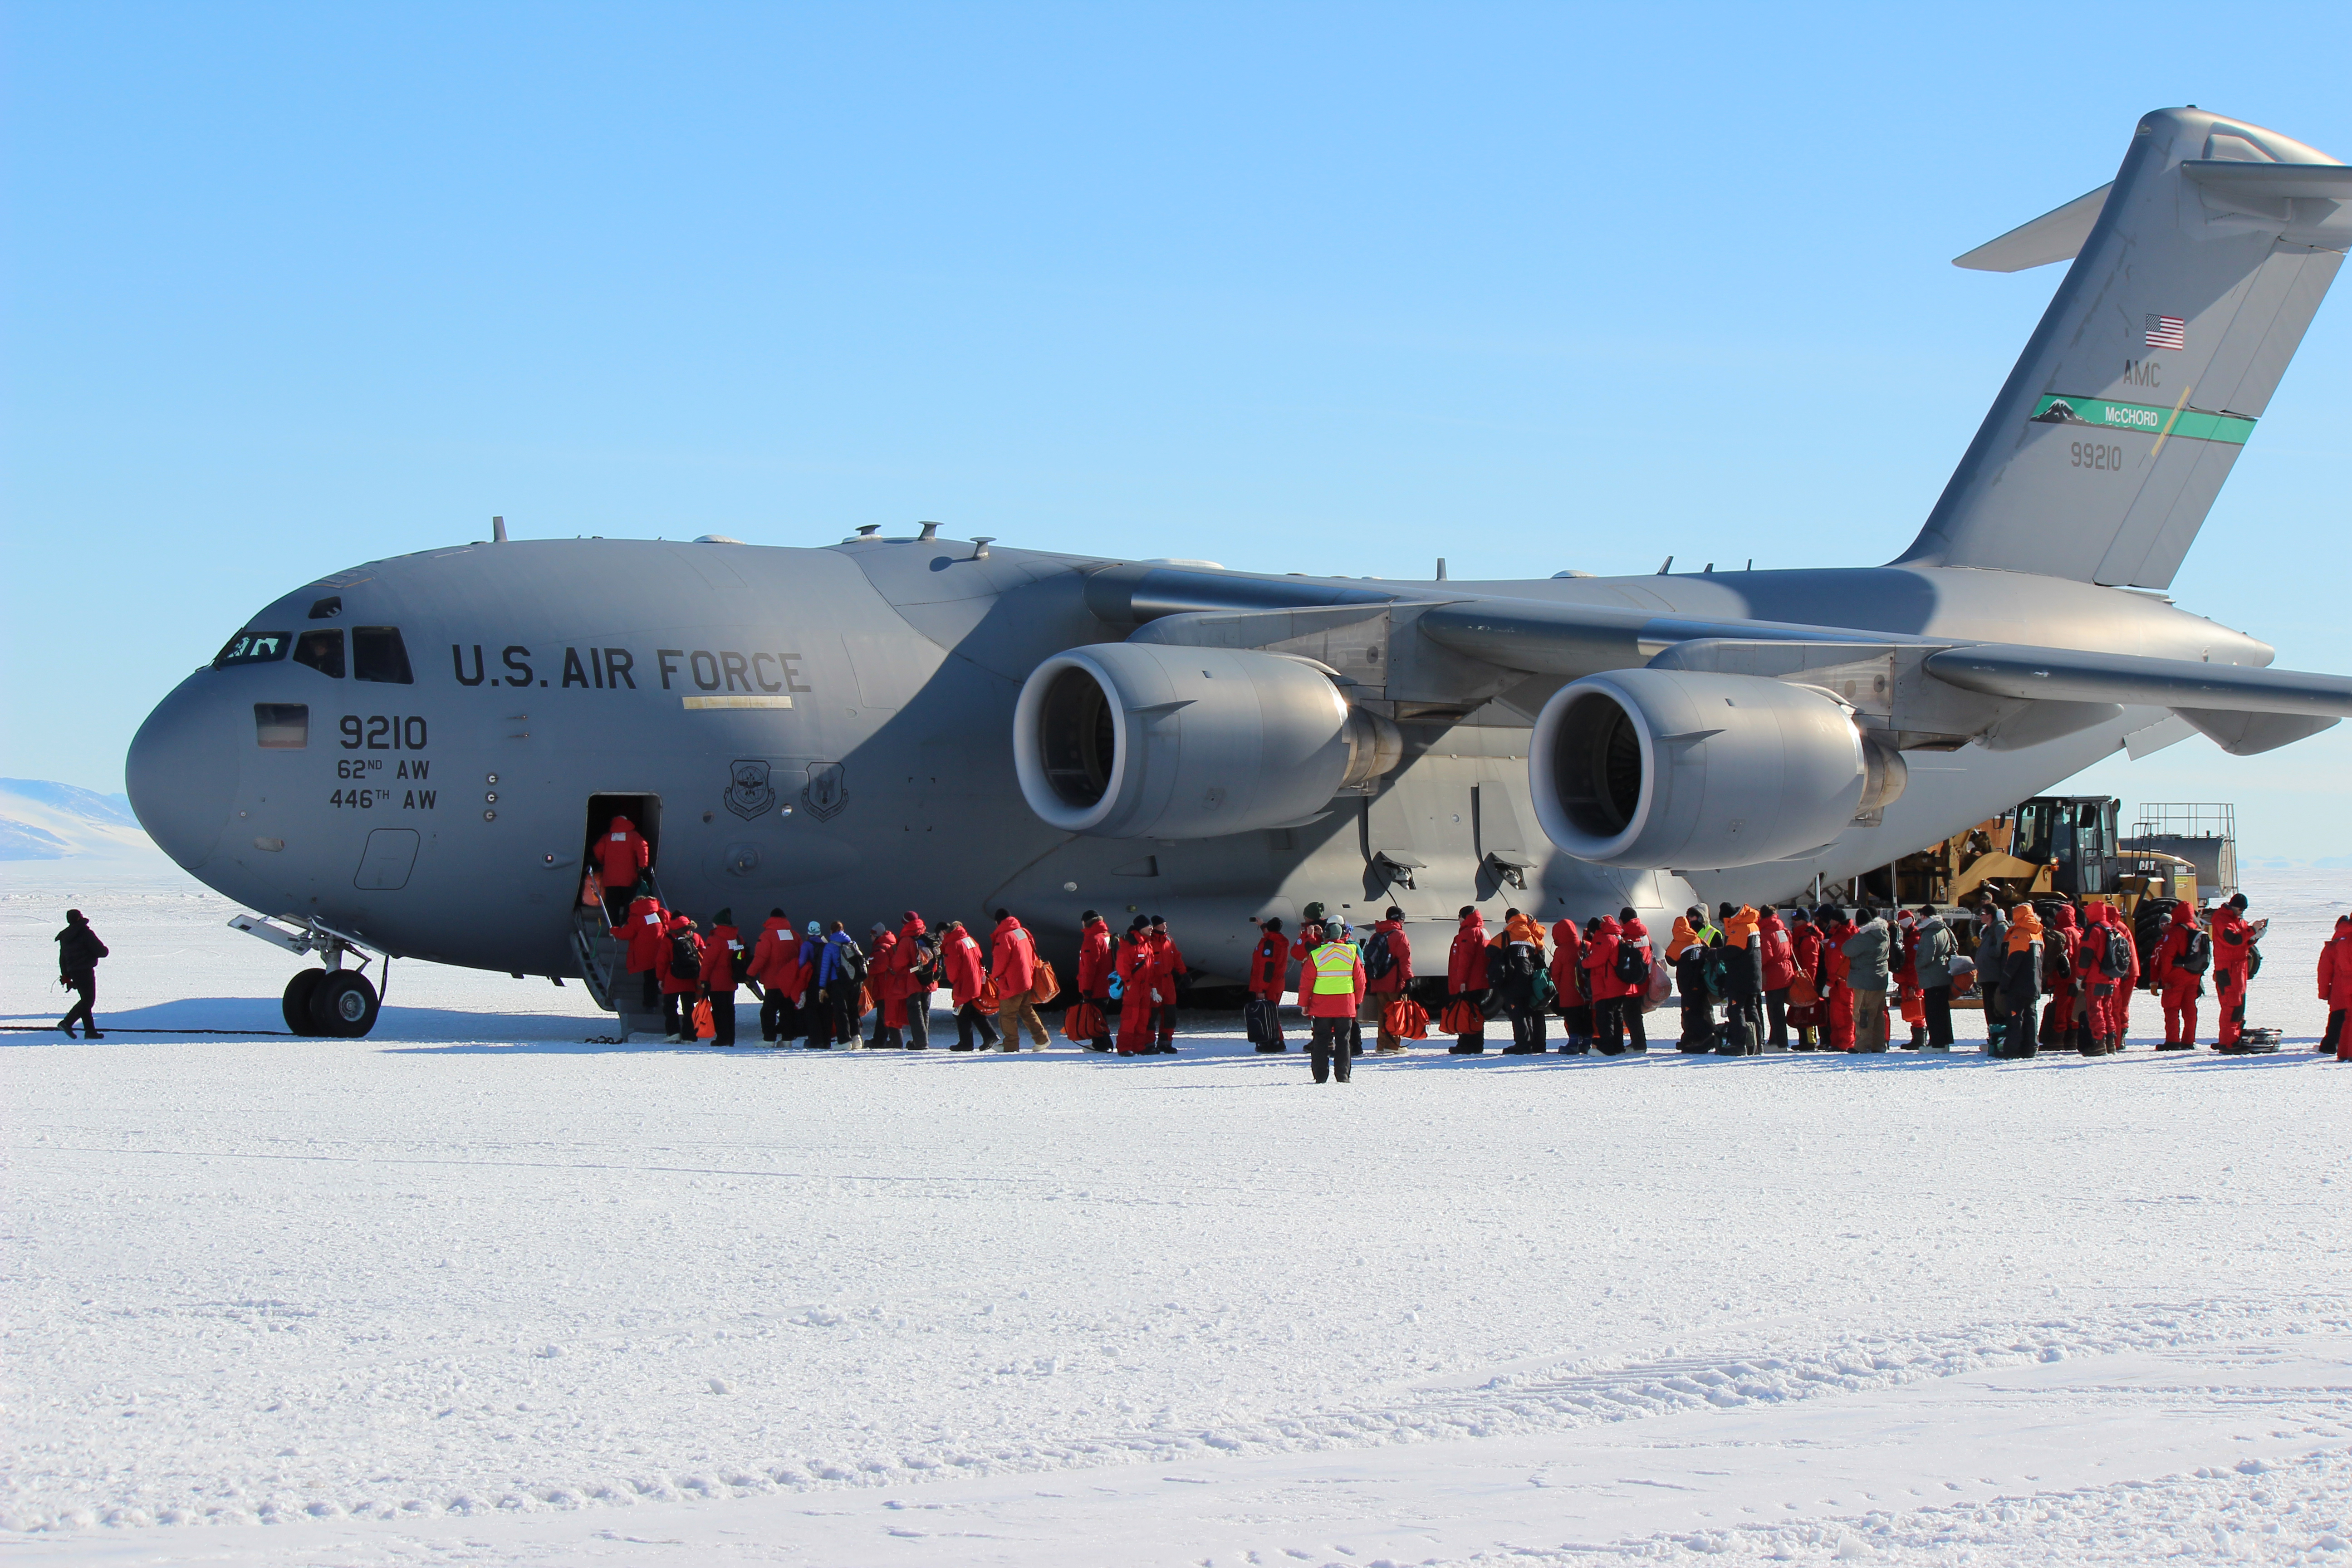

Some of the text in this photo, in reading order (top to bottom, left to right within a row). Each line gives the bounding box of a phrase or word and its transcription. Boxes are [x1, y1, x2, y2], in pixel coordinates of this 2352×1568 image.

[2123, 359, 2161, 388] AMC
[2105, 407, 2158, 426] McCHORD
[2071, 442, 2122, 471] 99210
[452, 644, 812, 692] U.S. AIR FORCE
[340, 715, 427, 750] 9210
[397, 760, 430, 779] AW
[403, 790, 437, 809] AW
[2139, 860, 2156, 870] CAT
